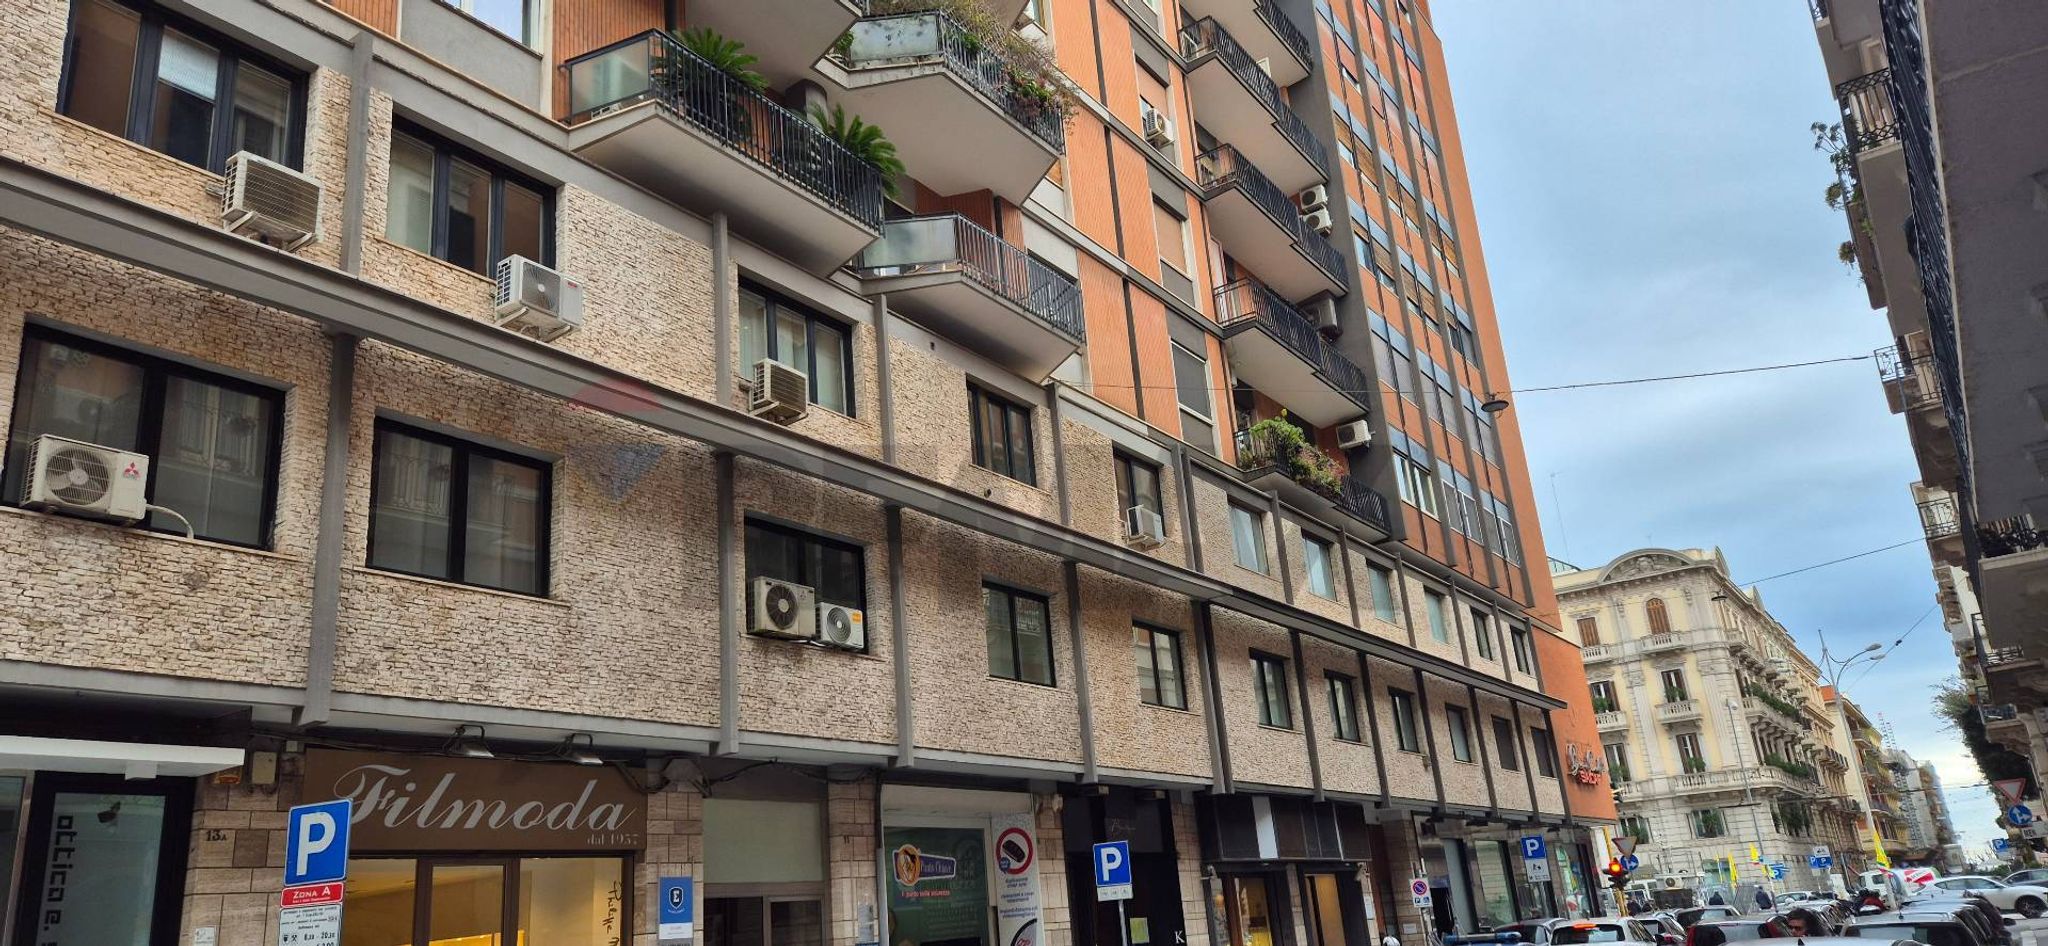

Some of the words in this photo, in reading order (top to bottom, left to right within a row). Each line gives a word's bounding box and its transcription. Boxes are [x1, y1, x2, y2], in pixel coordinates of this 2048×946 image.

[333, 764, 637, 830] Filmoda
[296, 812, 336, 877] P
[587, 833, 604, 845] dal
[1525, 839, 1539, 856] P
[47, 815, 78, 902] ottica
[1100, 847, 1122, 882] P
[322, 886, 331, 896] A
[1174, 930, 1184, 943] K
